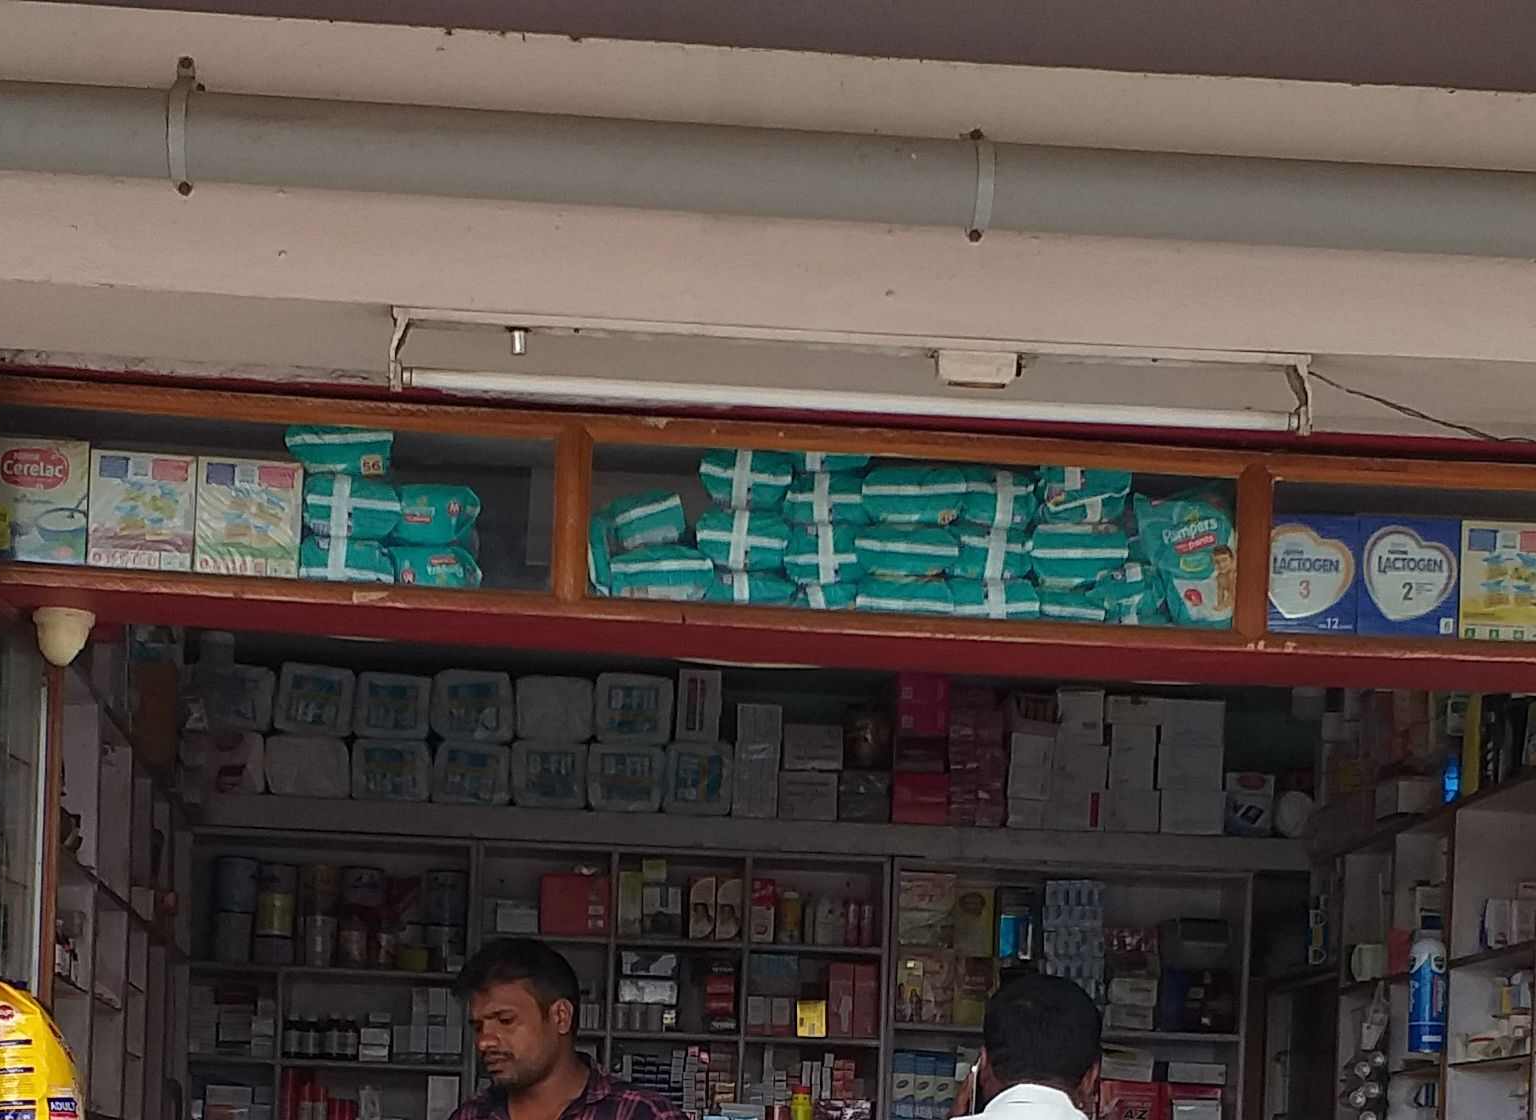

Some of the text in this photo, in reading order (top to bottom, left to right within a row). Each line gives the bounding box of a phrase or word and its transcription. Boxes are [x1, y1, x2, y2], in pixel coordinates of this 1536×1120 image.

[3, 460, 64, 478] Cerelac
[1163, 519, 1218, 543] Pampers
[1273, 556, 1341, 575] LACTOGEN
[1378, 556, 1444, 574] LACTOGEN
[1299, 580, 1311, 599] 3
[1402, 582, 1413, 601] 2
[1326, 618, 1340, 630] 12
[50, 1101, 76, 1112] ADULT
